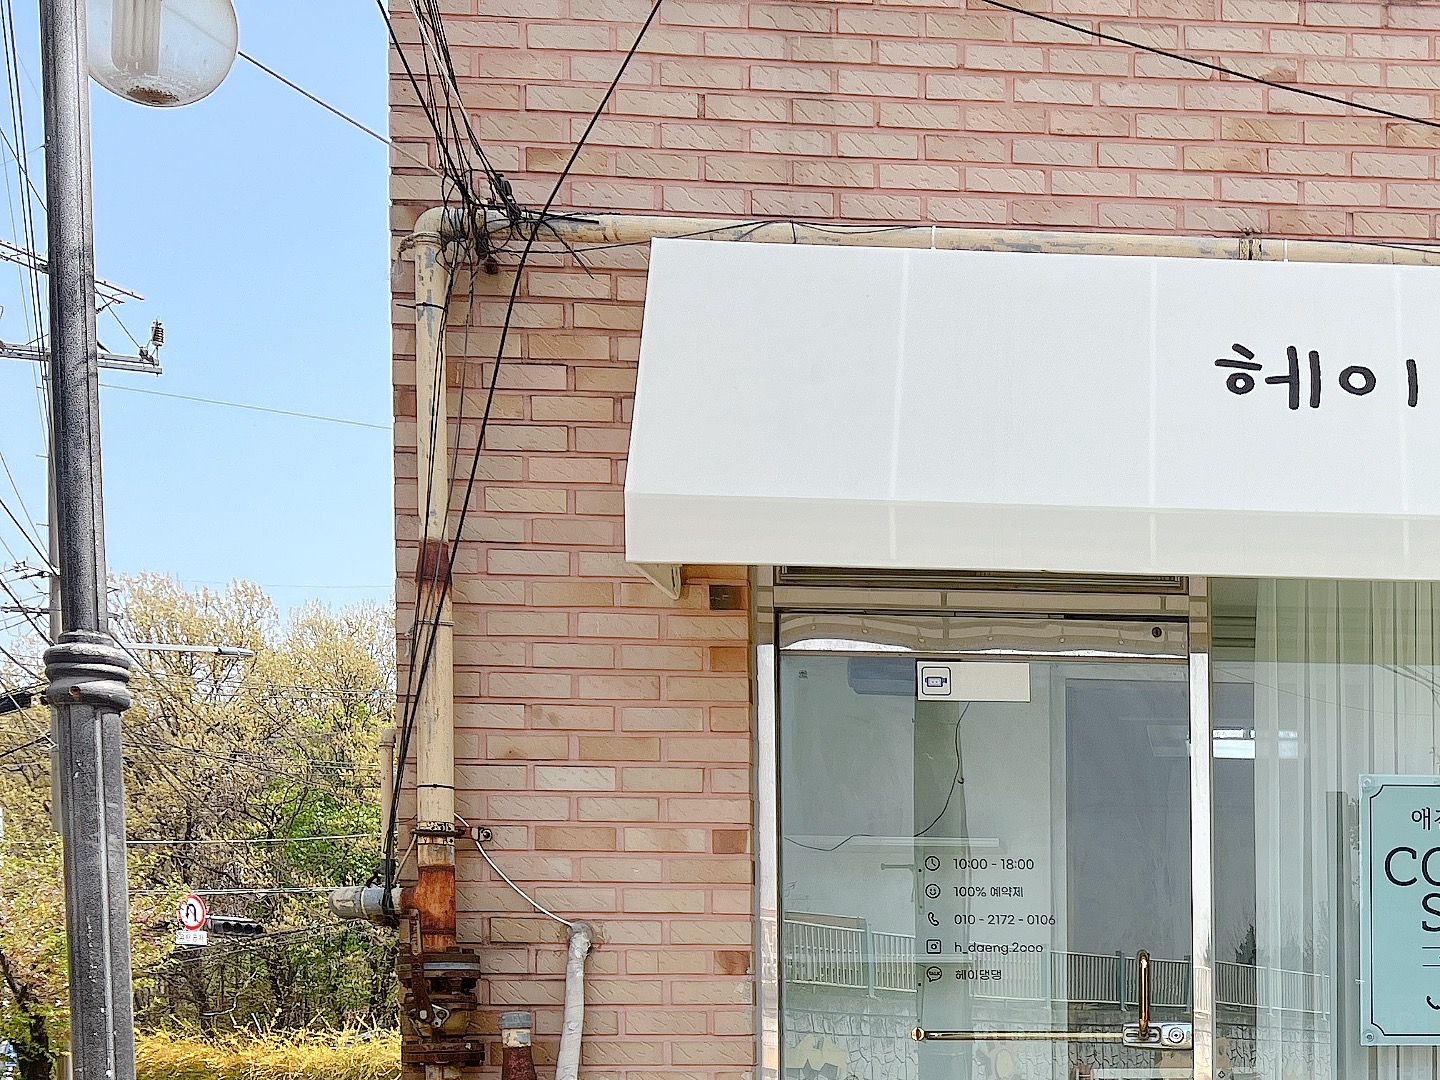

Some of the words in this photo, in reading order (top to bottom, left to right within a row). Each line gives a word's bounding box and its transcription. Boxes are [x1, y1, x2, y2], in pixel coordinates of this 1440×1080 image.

[953, 858, 988, 870] 10:00
[1000, 858, 1035, 870] 18:00
[953, 886, 987, 898] 100%
[990, 886, 1024, 898] 예약제
[954, 914, 976, 926] 010
[987, 914, 1015, 926] 2172
[1027, 914, 1056, 926] 0106
[955, 969, 1002, 980] 헤이댕댕
